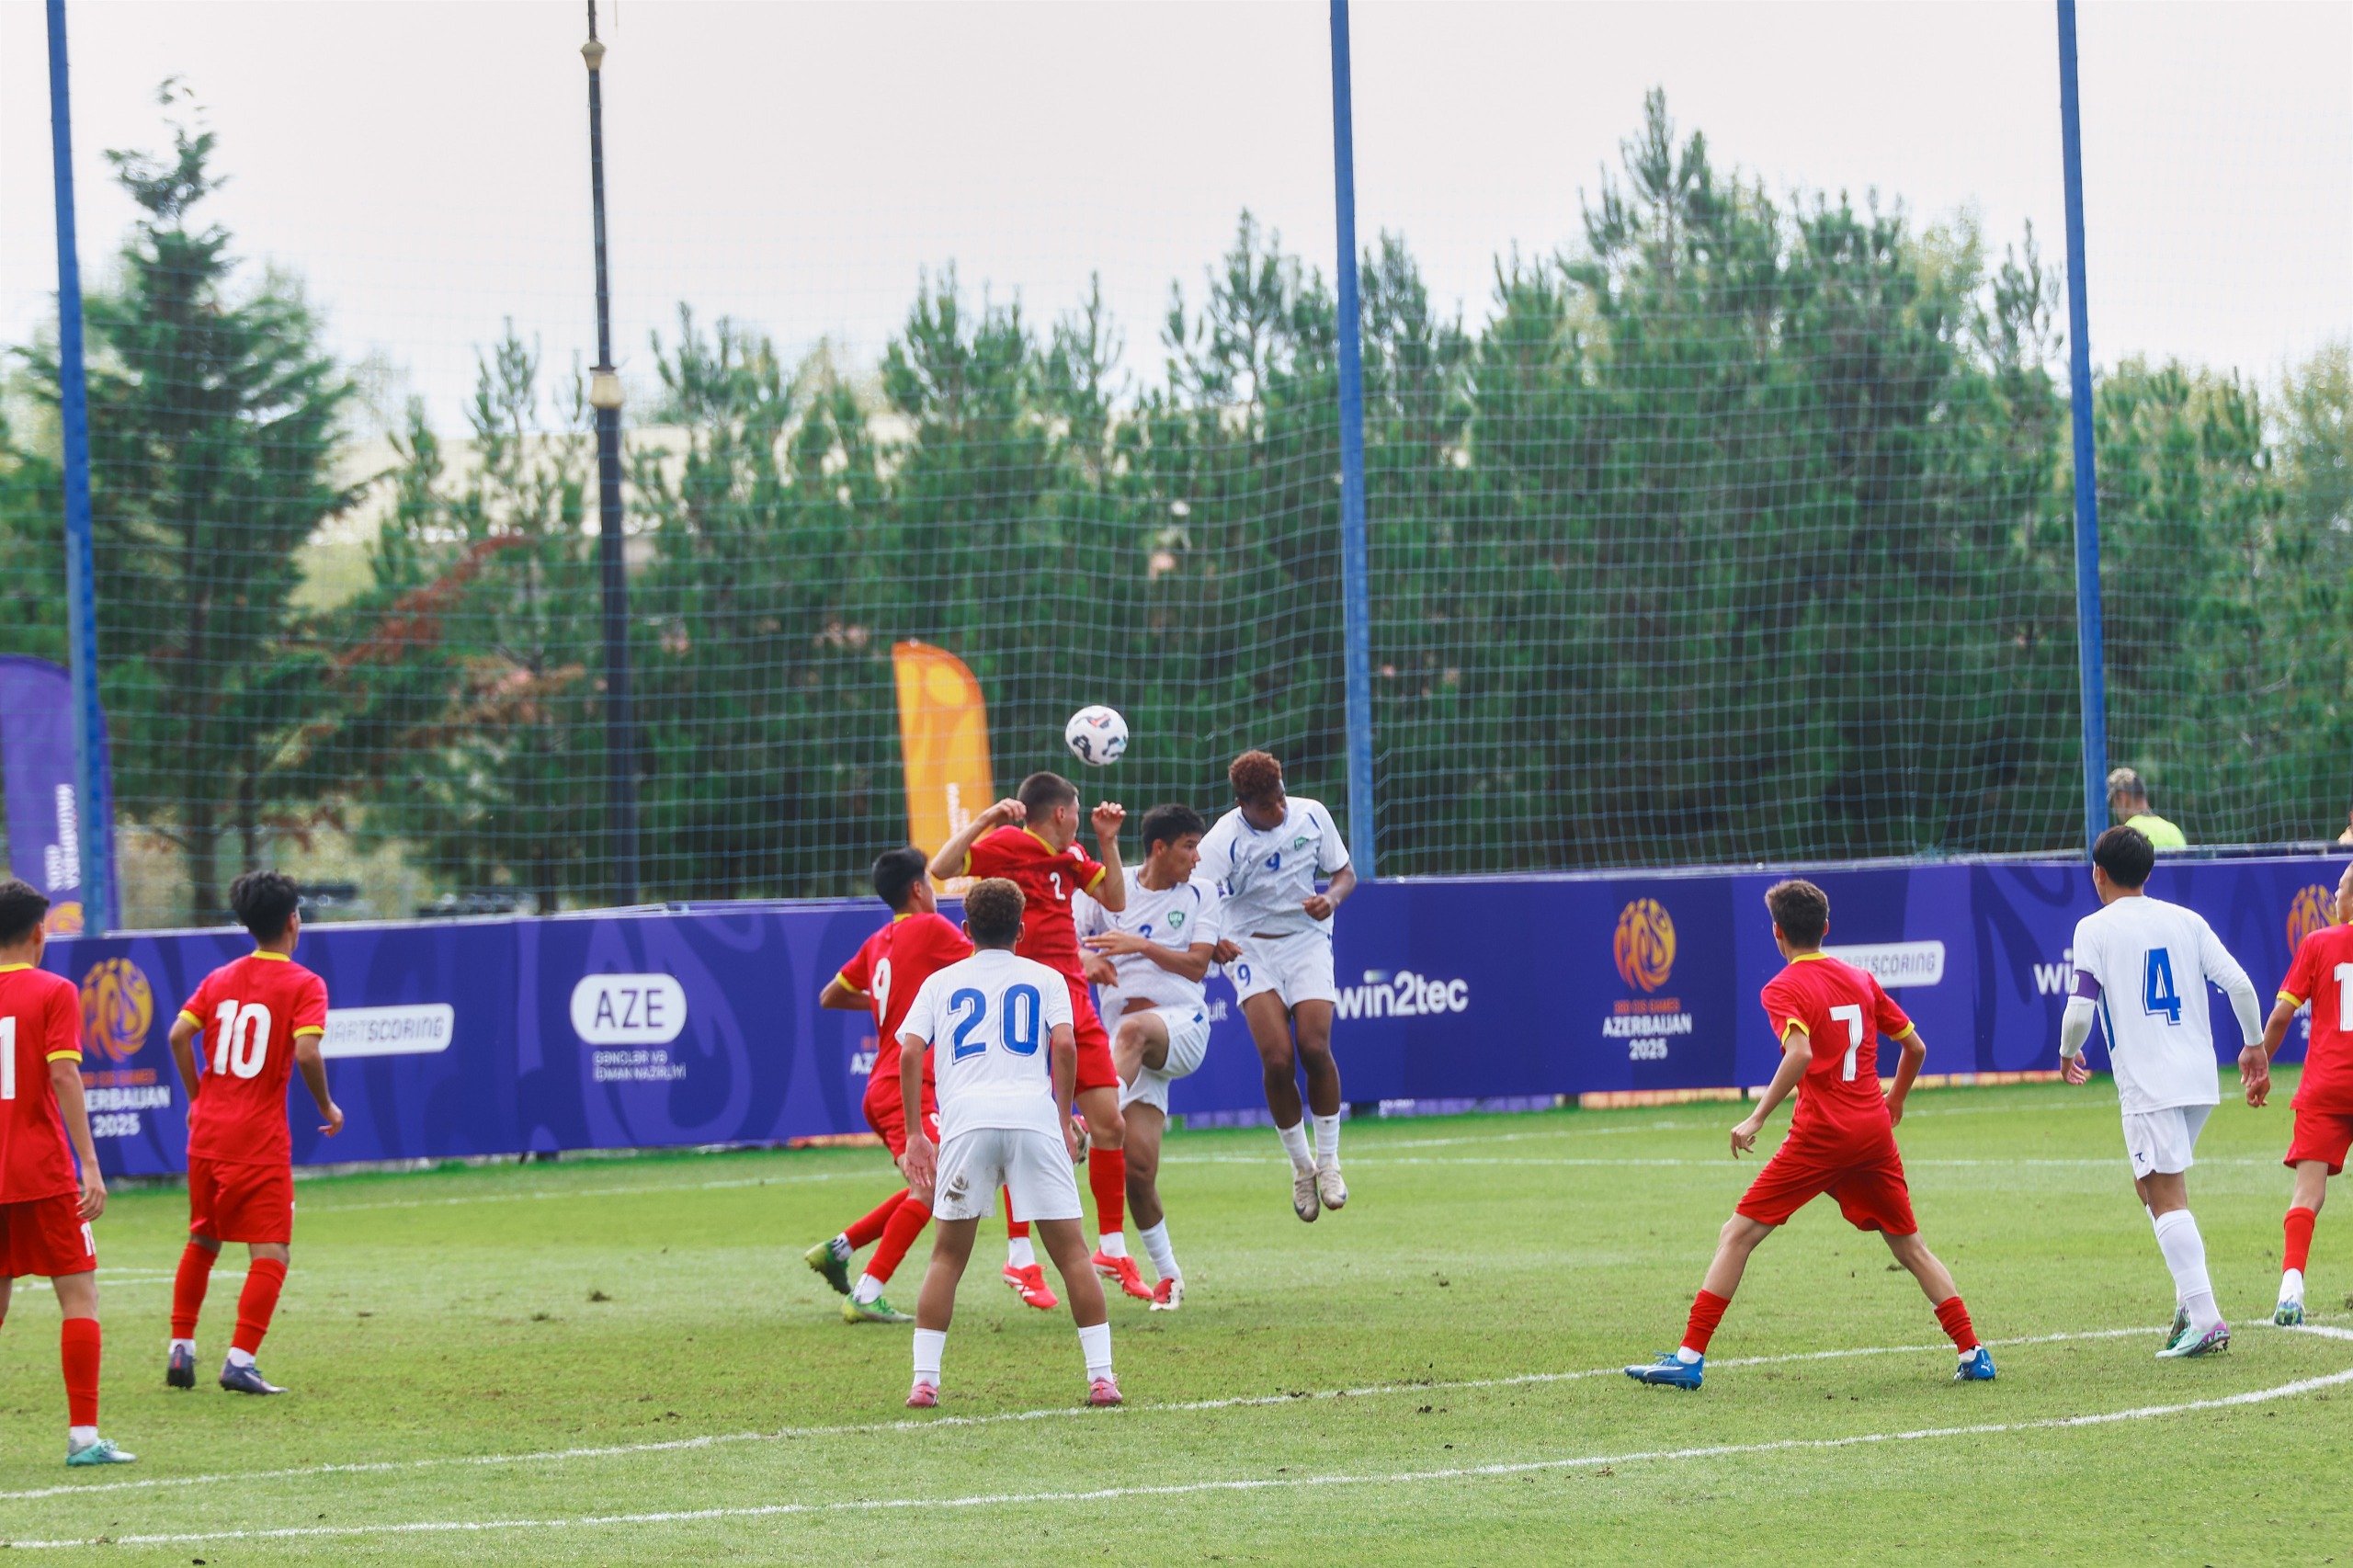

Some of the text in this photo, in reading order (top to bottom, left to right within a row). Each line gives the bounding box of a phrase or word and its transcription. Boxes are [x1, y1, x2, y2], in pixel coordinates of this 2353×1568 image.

[1049, 871, 1067, 901] 2
[1265, 851, 1281, 871] 9
[871, 957, 892, 1028] 9
[1236, 963, 1251, 987] 9
[1334, 970, 1469, 1020] win2tec
[2142, 947, 2182, 1026] 4
[2334, 961, 2353, 1032] 1
[594, 990, 664, 1028] AZE
[947, 983, 1041, 1065] 20
[1602, 1013, 1692, 1038] AZERBAIJAN
[0, 1016, 16, 1099] 1
[213, 999, 272, 1080] 10
[1629, 1038, 1667, 1060] 2025
[1829, 1004, 1863, 1082] 7
[93, 1112, 141, 1139] 2025
